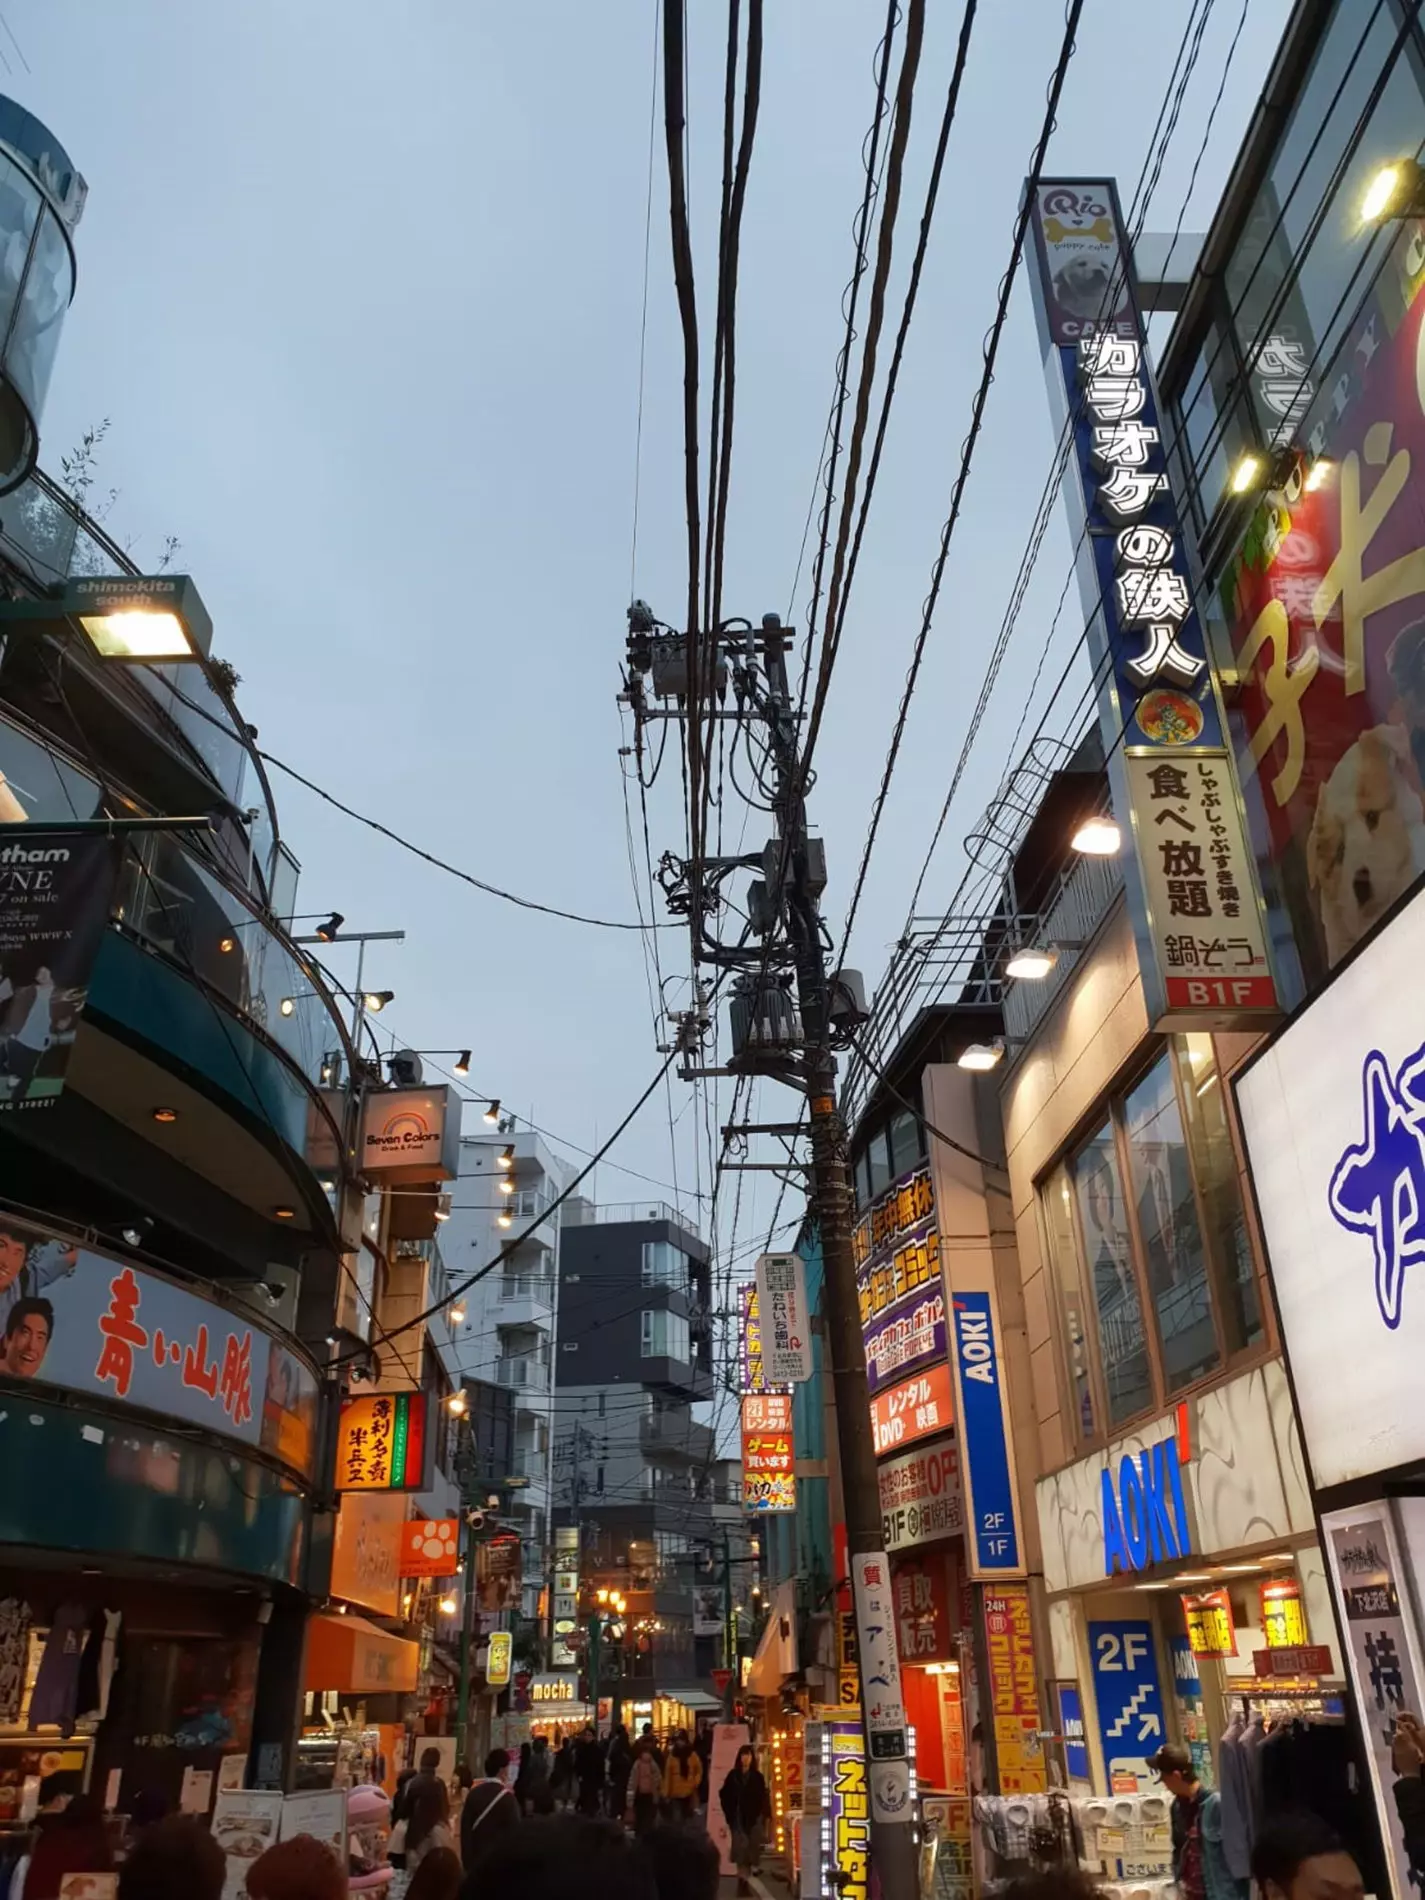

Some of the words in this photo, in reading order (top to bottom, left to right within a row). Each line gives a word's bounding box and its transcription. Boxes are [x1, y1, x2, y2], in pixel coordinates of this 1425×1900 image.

[1074, 332, 1208, 681] カラオケの鉄人
[76, 580, 175, 593] shimokita
[1146, 763, 1213, 917] 食べ放題
[1197, 762, 1241, 918] しゃぶしゃぶすき焼き
[1187, 981, 1252, 1004] B1F
[366, 1135, 401, 1145] Seven
[403, 1132, 440, 1142] Colors
[960, 1312, 994, 1384] AOKI
[888, 1379, 932, 1417] レンタル
[747, 1439, 789, 1453] ゲーム
[1100, 1436, 1192, 1577] AOKI
[984, 1513, 1004, 1529] 2F
[987, 1540, 1009, 1555] 1F
[1096, 1632, 1148, 1672] 2F
[532, 1679, 573, 1699] mocha
[1126, 1862, 1174, 1876] ございま
